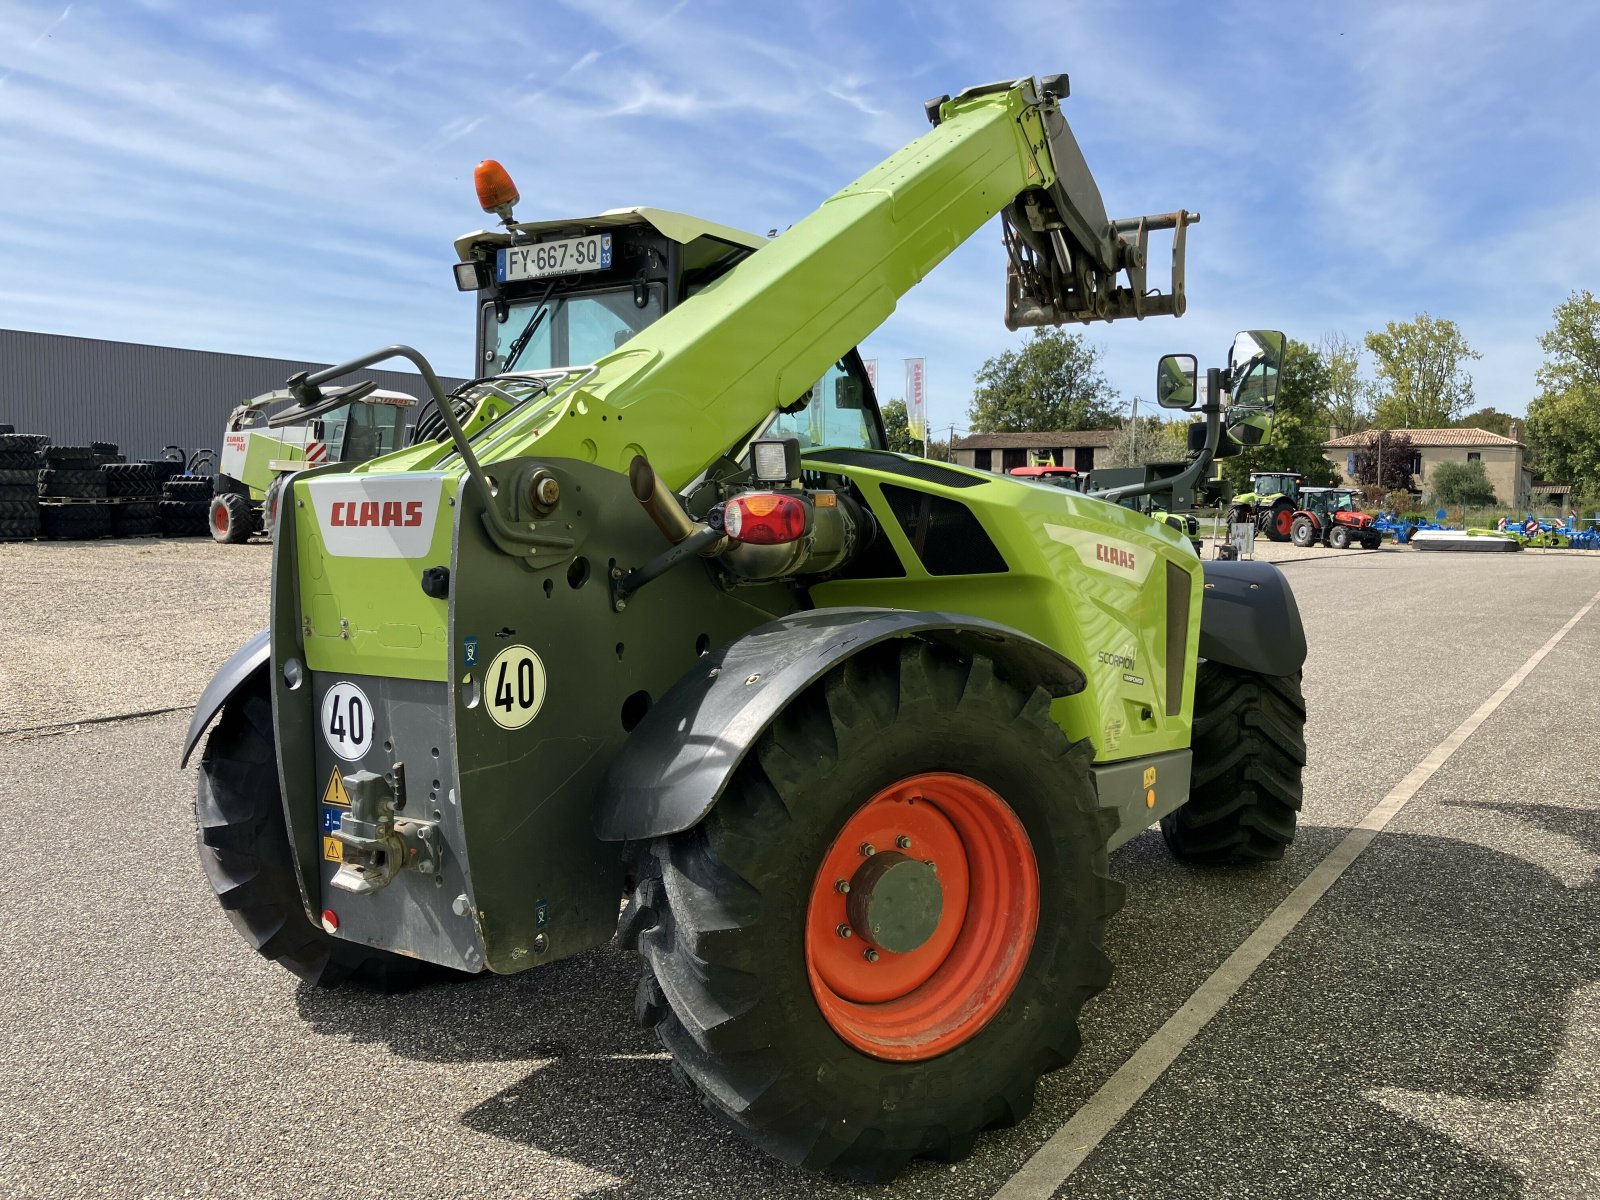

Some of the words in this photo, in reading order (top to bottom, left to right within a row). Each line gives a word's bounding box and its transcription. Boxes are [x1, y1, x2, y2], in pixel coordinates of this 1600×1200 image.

[509, 239, 597, 274] FY-667-SQ
[602, 252, 611, 264] 33
[499, 268, 504, 276] F
[330, 501, 423, 527] CLAAS
[1096, 543, 1135, 570] CLAAS
[1098, 651, 1136, 671] SCORPION
[1123, 644, 1138, 661] 741
[495, 657, 534, 713] 40
[330, 694, 364, 746] 40
